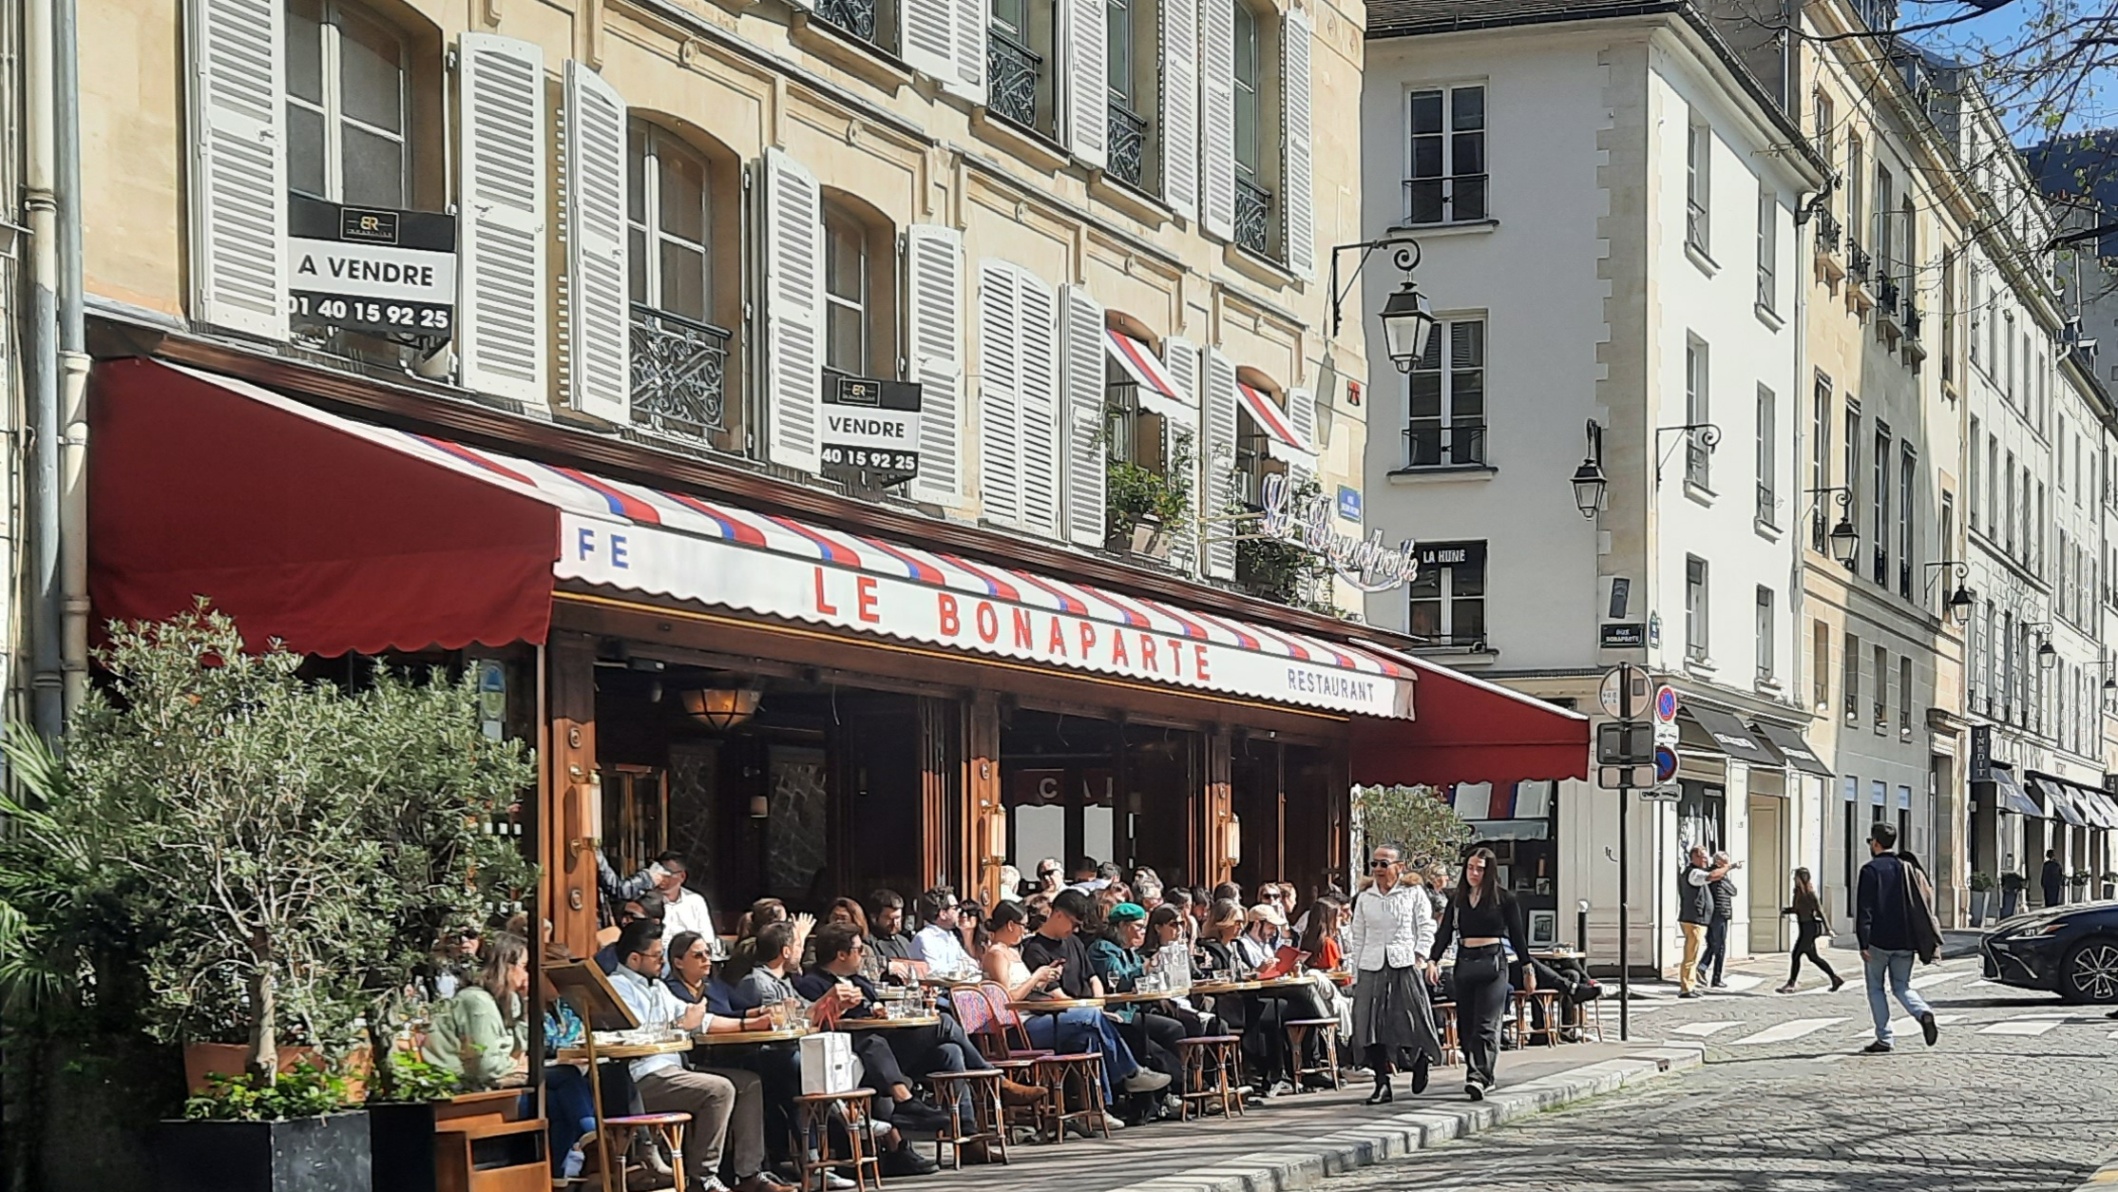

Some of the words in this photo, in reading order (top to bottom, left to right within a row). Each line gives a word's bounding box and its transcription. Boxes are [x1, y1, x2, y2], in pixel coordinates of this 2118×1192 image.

[298, 255, 317, 275] A
[327, 257, 433, 287] VENDRE
[317, 300, 346, 319] 40
[354, 303, 380, 322] 15
[387, 306, 414, 325] 92
[420, 310, 448, 328] 25
[828, 416, 905, 438] VENDRE
[822, 448, 842, 463] 40
[848, 450, 866, 466] 15
[870, 452, 891, 468] 92
[895, 455, 915, 470] 25
[1423, 550, 1436, 563] LA
[1438, 549, 1465, 562] HUNE
[814, 566, 880, 623] LE
[938, 592, 1211, 682] BONAPARTE
[1287, 668, 1374, 702] RESTAURANT
